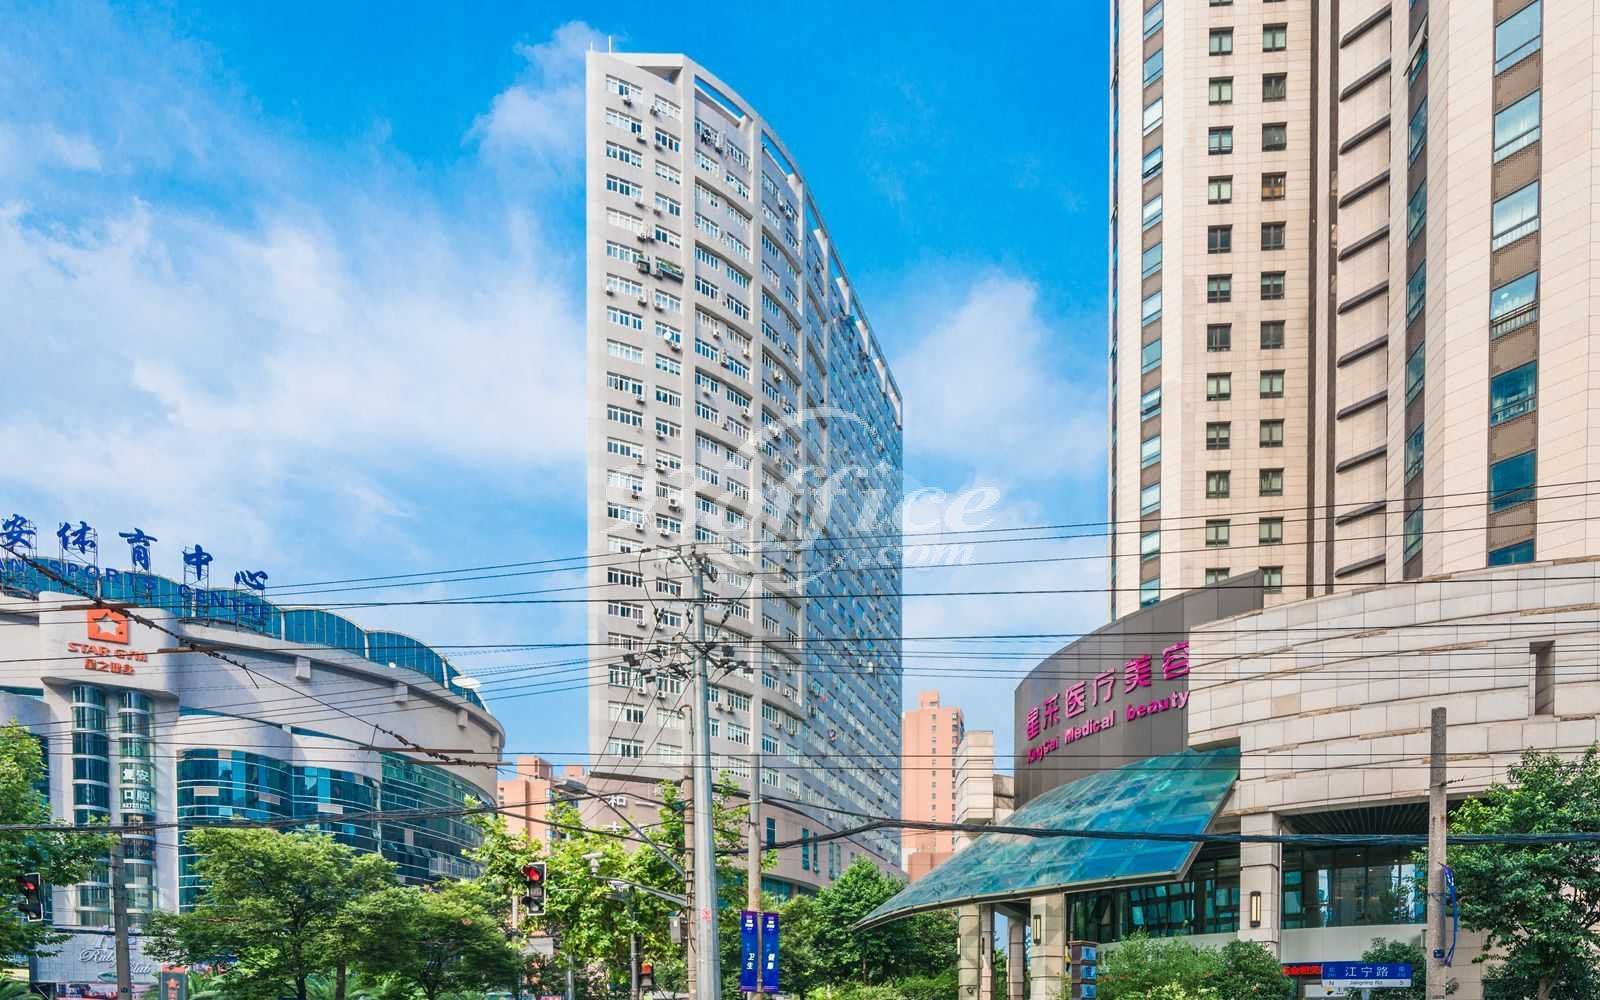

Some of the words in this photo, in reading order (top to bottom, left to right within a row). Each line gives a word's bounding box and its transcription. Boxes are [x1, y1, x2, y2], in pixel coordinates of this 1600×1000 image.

[48, 560, 158, 590] SPORTS
[68, 642, 110, 656] STAR
[1064, 710, 1116, 745] Medical
[1125, 690, 1190, 722] beauty
[1345, 966, 1390, 977] 江宁路
